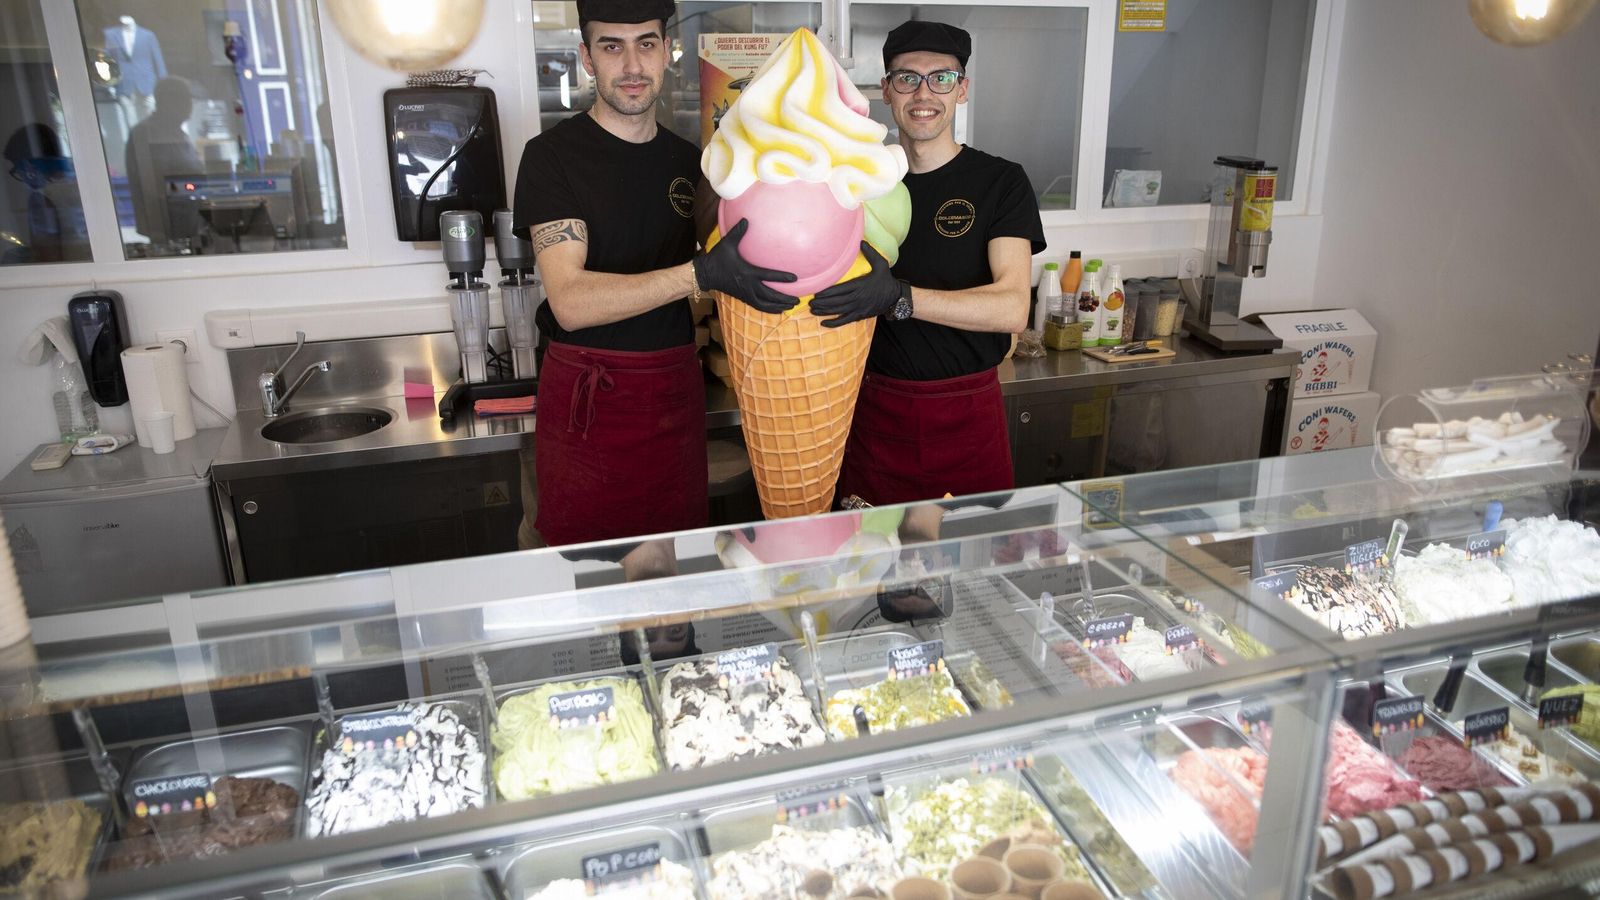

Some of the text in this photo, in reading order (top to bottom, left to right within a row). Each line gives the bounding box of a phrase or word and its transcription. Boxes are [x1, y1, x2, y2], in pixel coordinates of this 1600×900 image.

[714, 36, 737, 44] ¿QUIERES
[1295, 322, 1348, 333] FRAGILE
[1301, 341, 1354, 364] CONI WAFERS
[1304, 381, 1337, 391] BABBI
[1298, 406, 1356, 432] CONI WAFERS
[1349, 542, 1378, 556] ZUPPA
[1087, 621, 1126, 634] CEREZA
[1543, 699, 1578, 714] NUEZ
